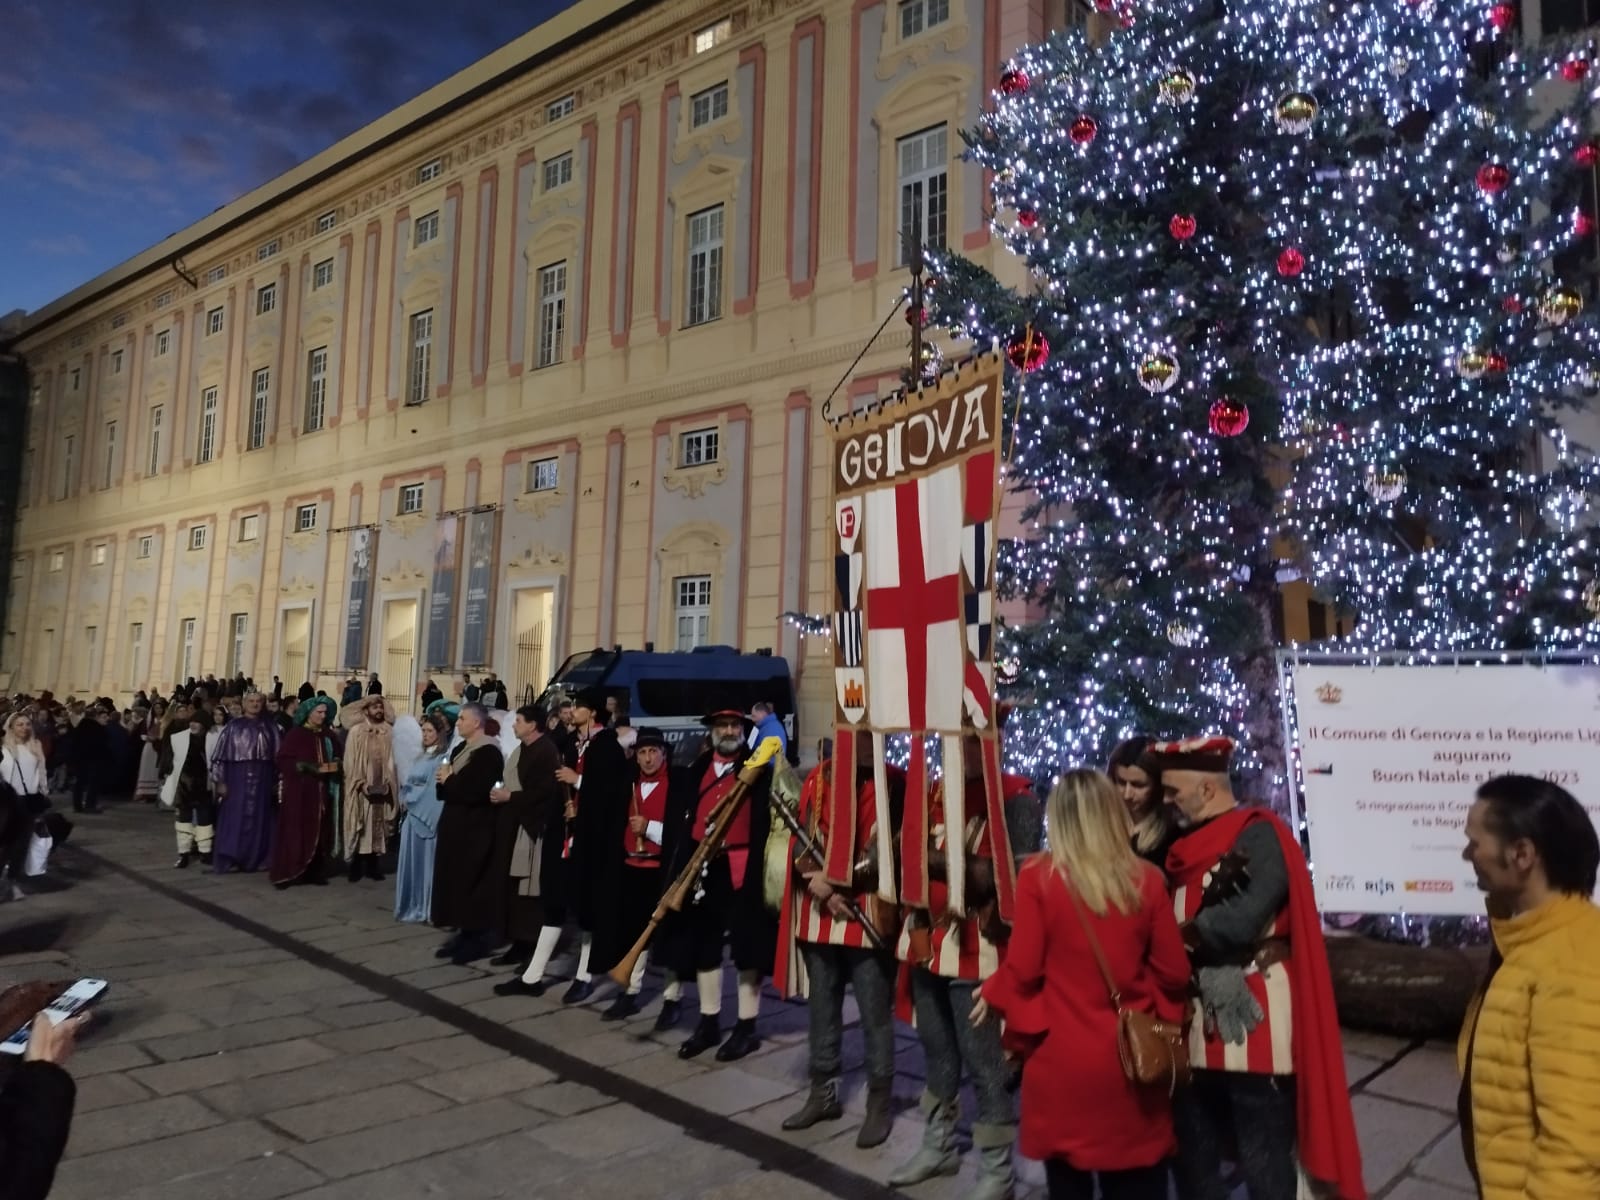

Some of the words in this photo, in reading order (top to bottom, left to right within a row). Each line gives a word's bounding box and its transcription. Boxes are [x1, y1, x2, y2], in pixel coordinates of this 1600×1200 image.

[1309, 727, 1318, 740] Il
[1322, 727, 1387, 740] Comune
[1392, 727, 1406, 740] di
[1410, 727, 1471, 741] Genova
[1476, 731, 1485, 741] e
[1489, 728, 1502, 740] la
[1507, 728, 1573, 744] Regione
[1433, 751, 1511, 765] augurano
[1373, 769, 1414, 783] Buon
[1418, 769, 1470, 783] Natale
[1475, 773, 1484, 783] e
[1369, 800, 1435, 814] ringraziano
